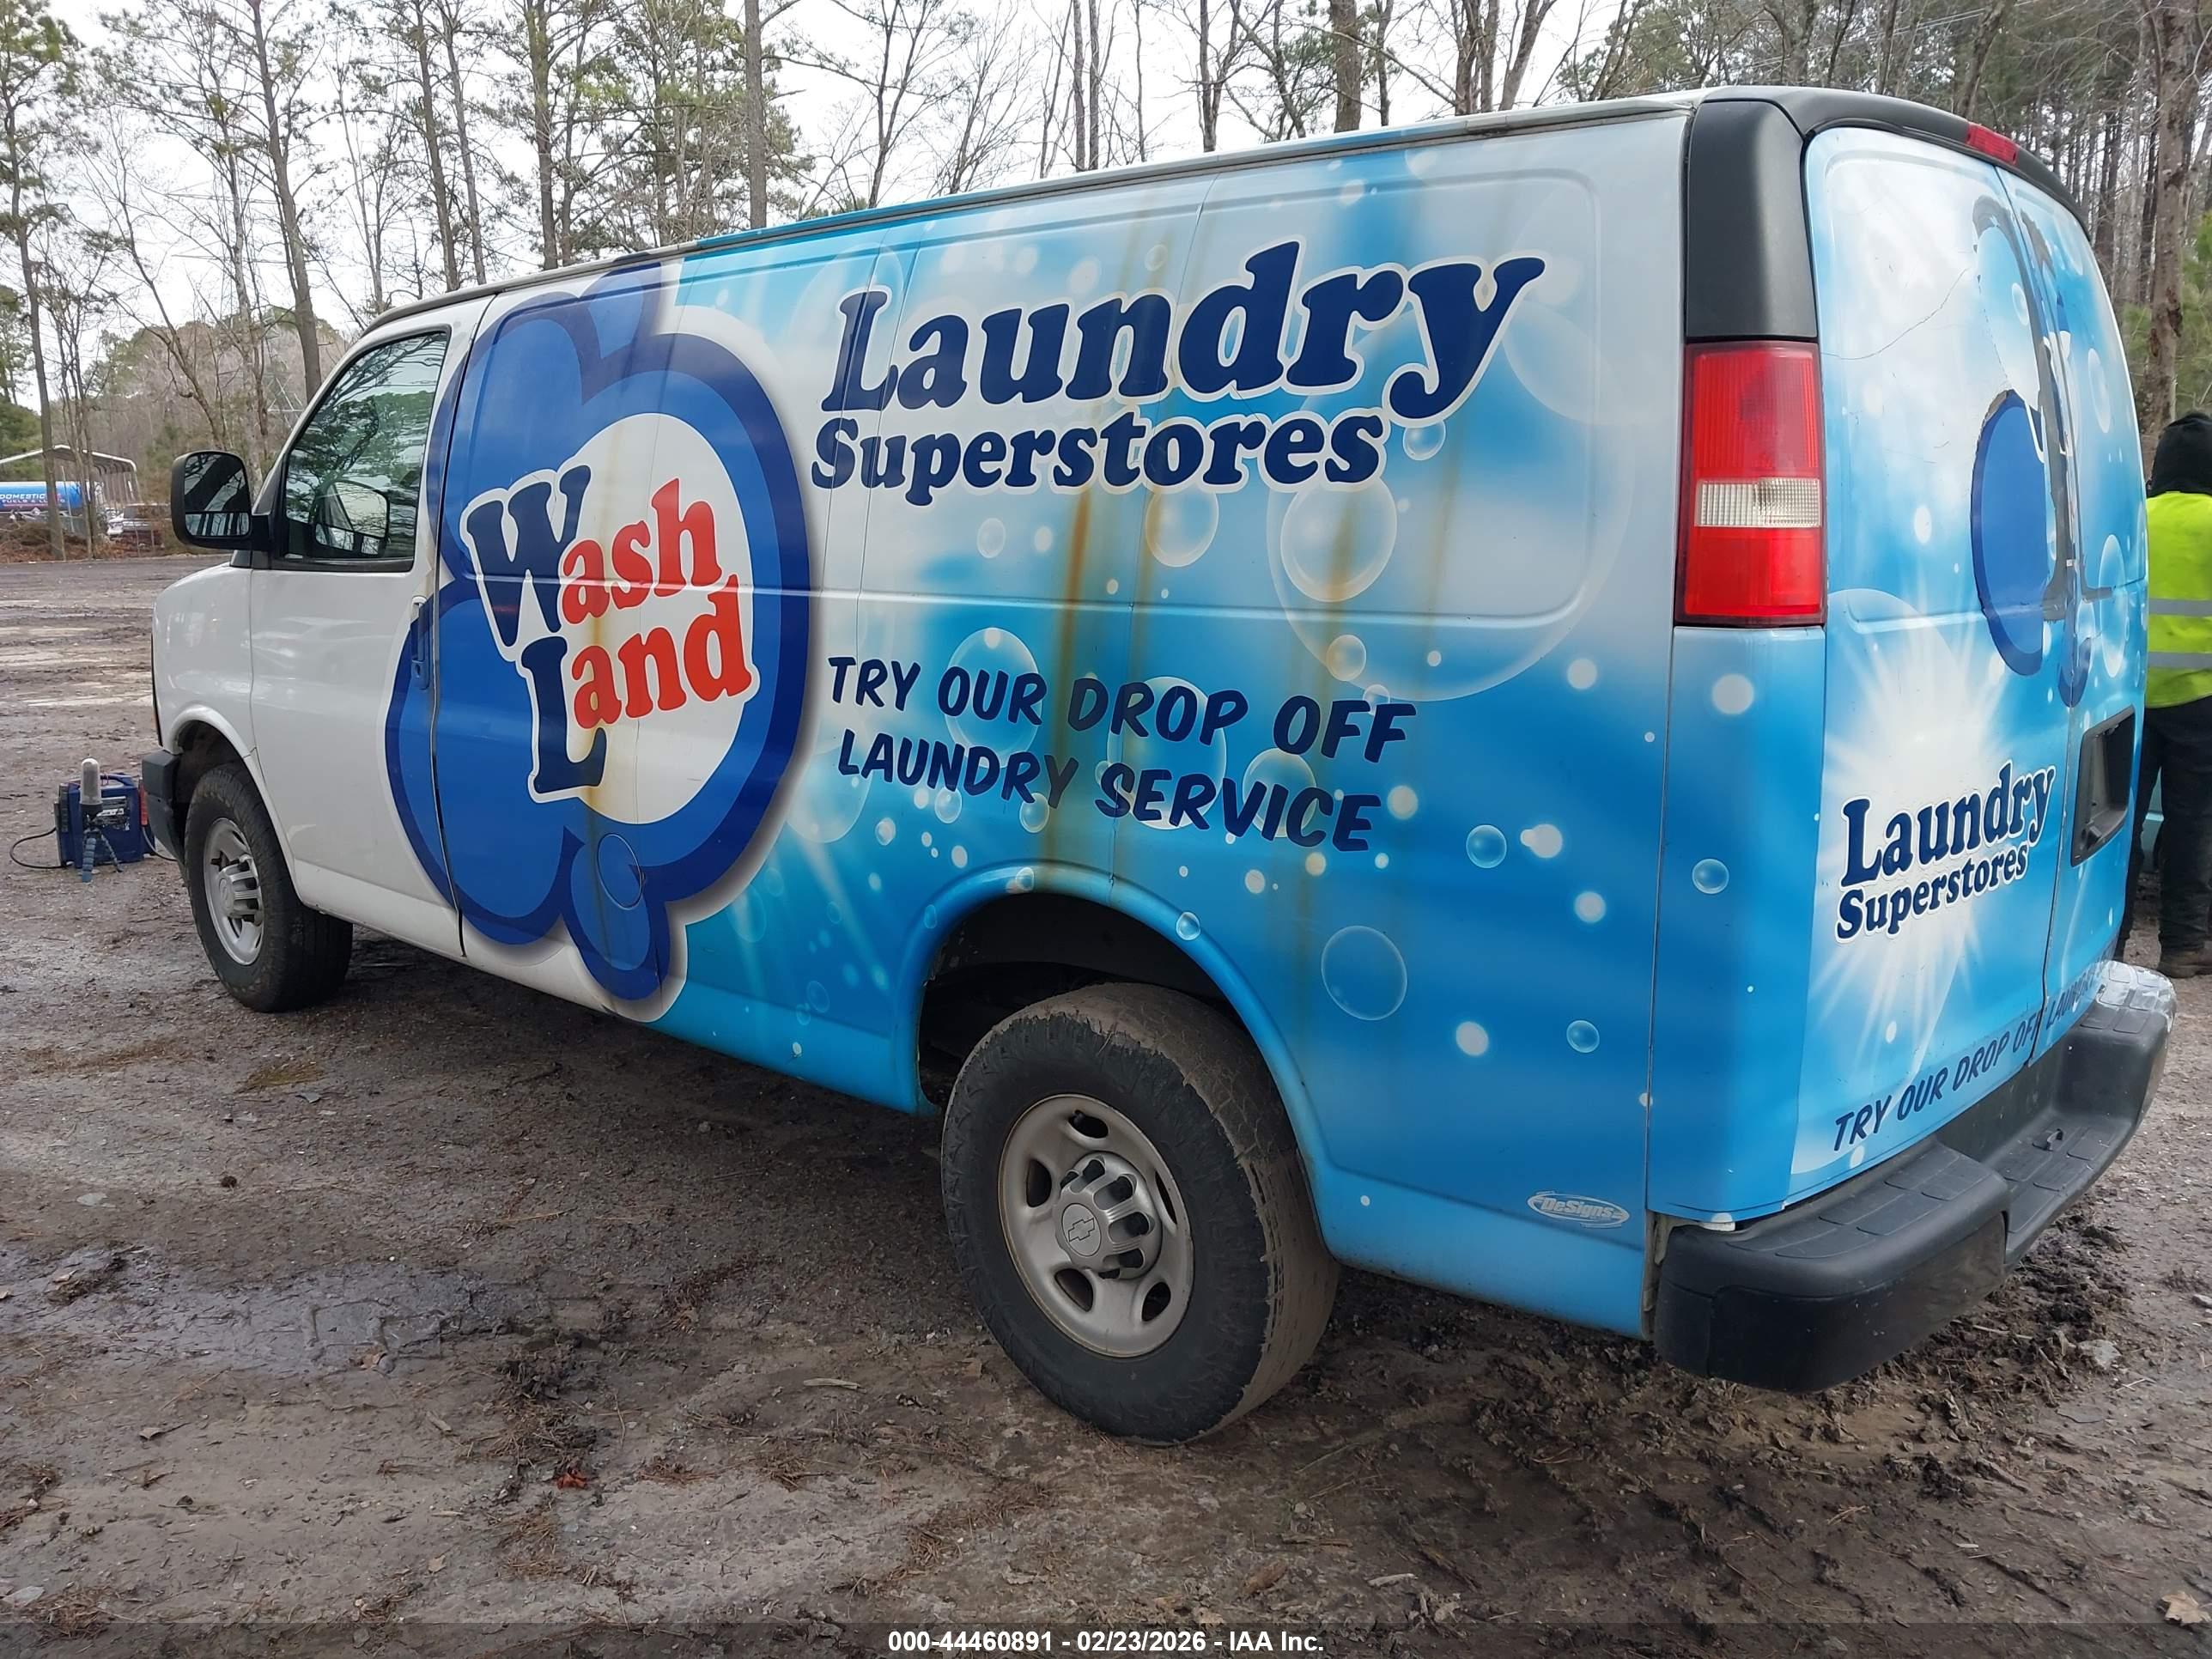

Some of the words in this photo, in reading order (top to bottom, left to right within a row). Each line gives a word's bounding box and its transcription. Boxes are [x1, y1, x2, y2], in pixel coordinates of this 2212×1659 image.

[821, 241, 1547, 420] Laundry
[811, 412, 1383, 506] Superstores
[466, 465, 722, 647] Wash
[520, 574, 752, 794] Land
[827, 656, 921, 712] TRY
[937, 665, 1048, 726] OUR
[1066, 678, 1249, 745] DROP
[1272, 695, 1417, 763] OFF
[836, 729, 1079, 810] LAUNDRY
[1093, 763, 1382, 852] SERVICE
[1840, 761, 2056, 887] Laundry
[1836, 842, 2027, 939] Superstores
[1833, 1095, 1893, 1152] TRY
[1897, 1067, 1948, 1121] OUR
[1953, 1030, 2020, 1091] DROP
